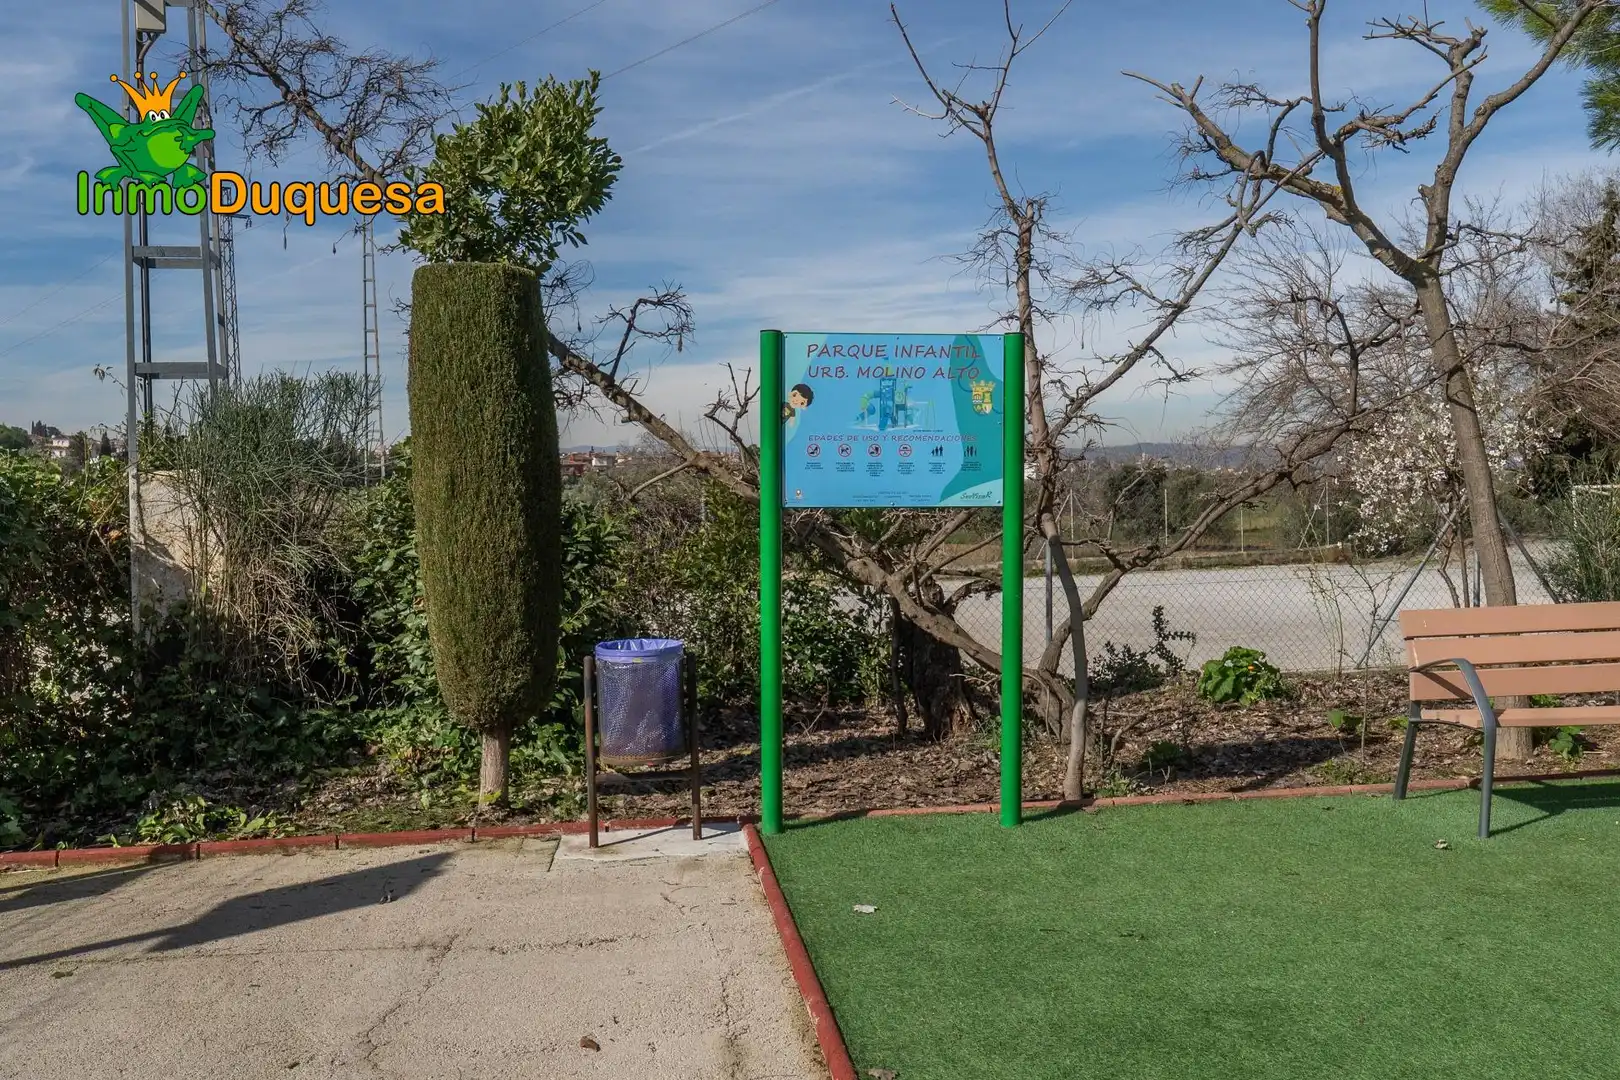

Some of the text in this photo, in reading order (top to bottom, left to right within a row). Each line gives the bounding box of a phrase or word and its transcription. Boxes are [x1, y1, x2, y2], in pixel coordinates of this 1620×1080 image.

[807, 344, 981, 359] PARQUE INFANTIL
[808, 366, 980, 380] URB. MOLINO ALTO
[808, 434, 844, 442] EDADES
[847, 434, 859, 442] DE
[862, 434, 880, 442] USO
[891, 434, 977, 442] RECOMENDACIONES
